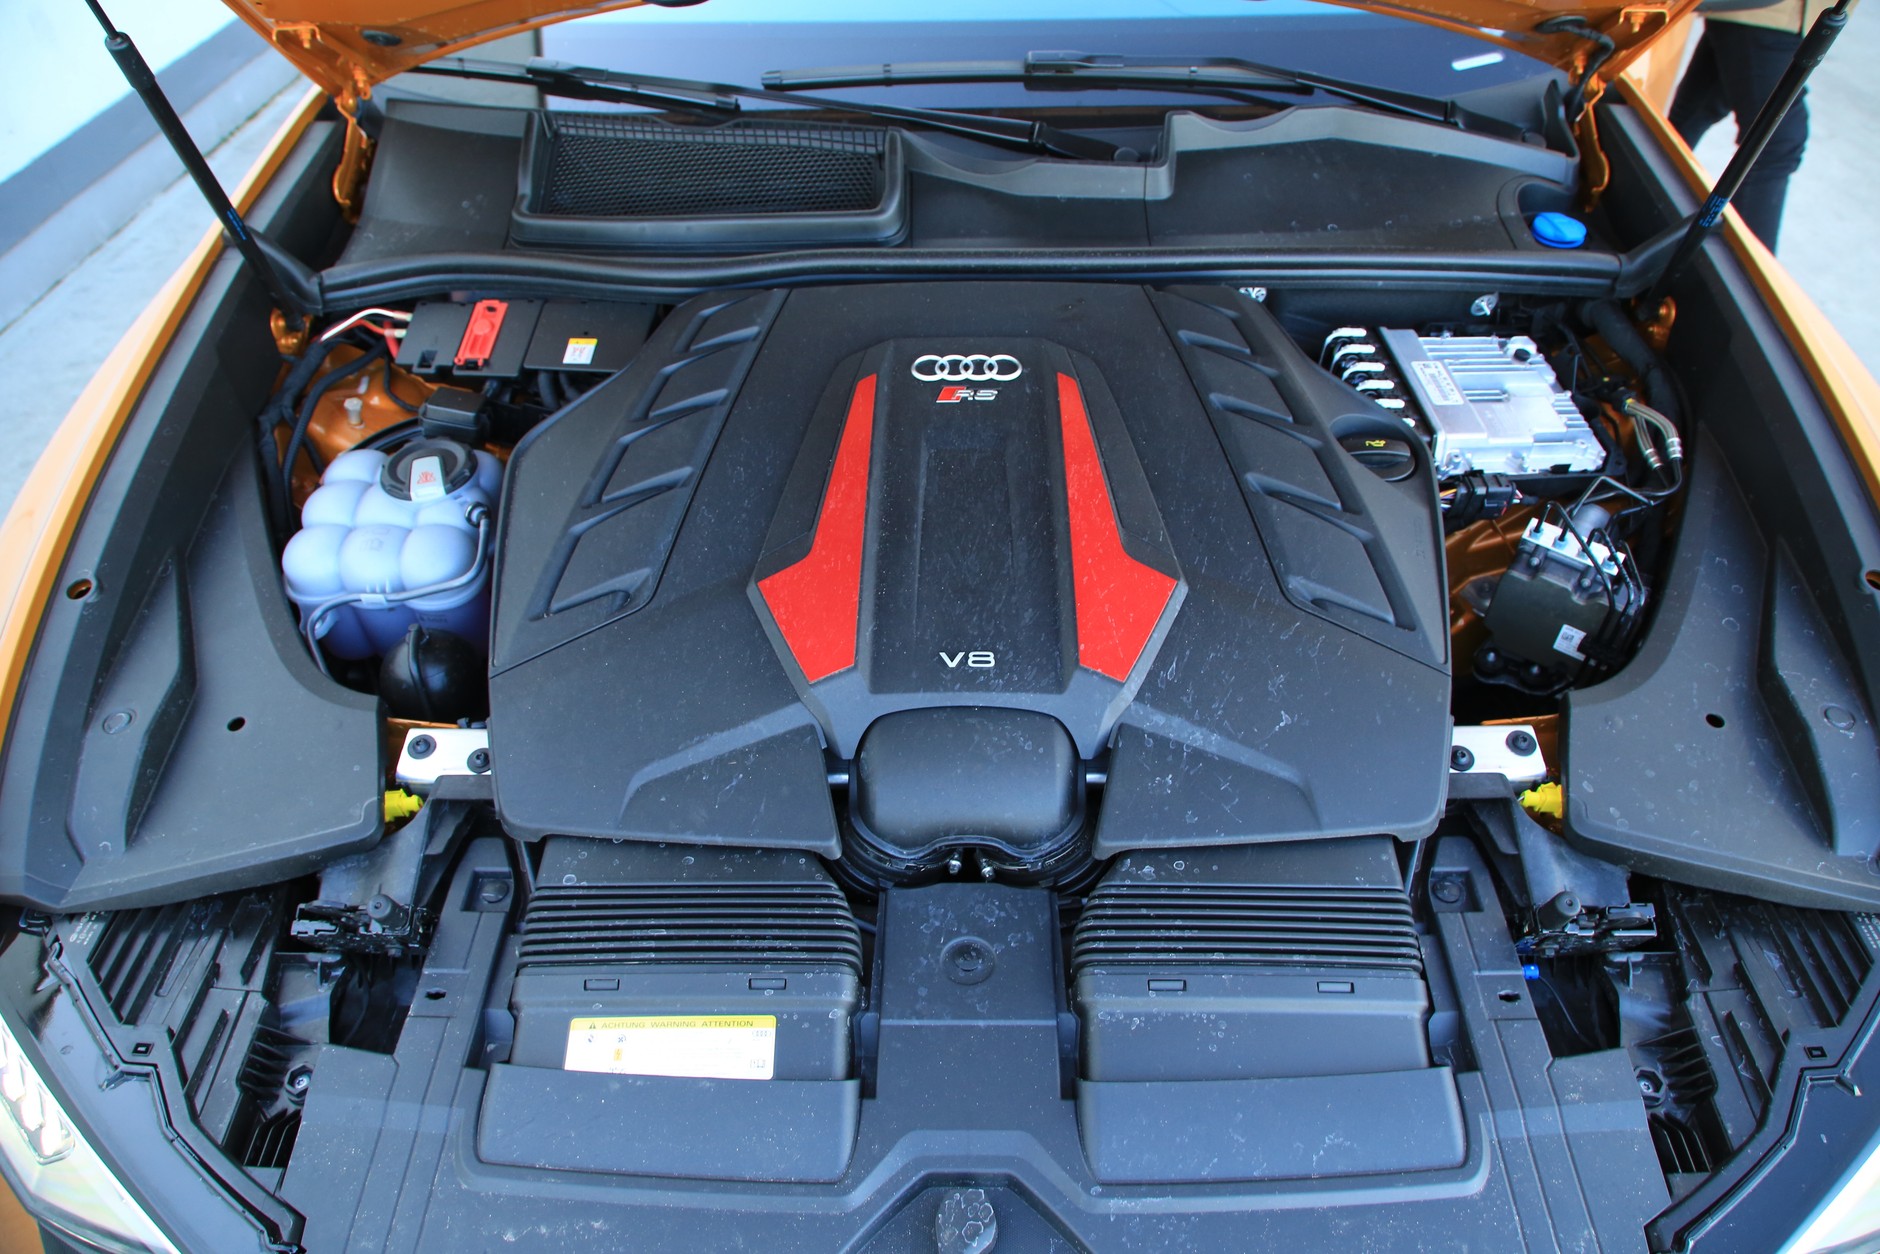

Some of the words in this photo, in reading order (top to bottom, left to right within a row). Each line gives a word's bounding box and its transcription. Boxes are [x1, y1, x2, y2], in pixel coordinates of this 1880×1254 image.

[948, 388, 998, 401] RS
[939, 651, 995, 668] V8
[601, 1021, 646, 1029] ACHTUNG
[650, 1020, 696, 1028] WARNING
[701, 1020, 754, 1028] ATTENTION
